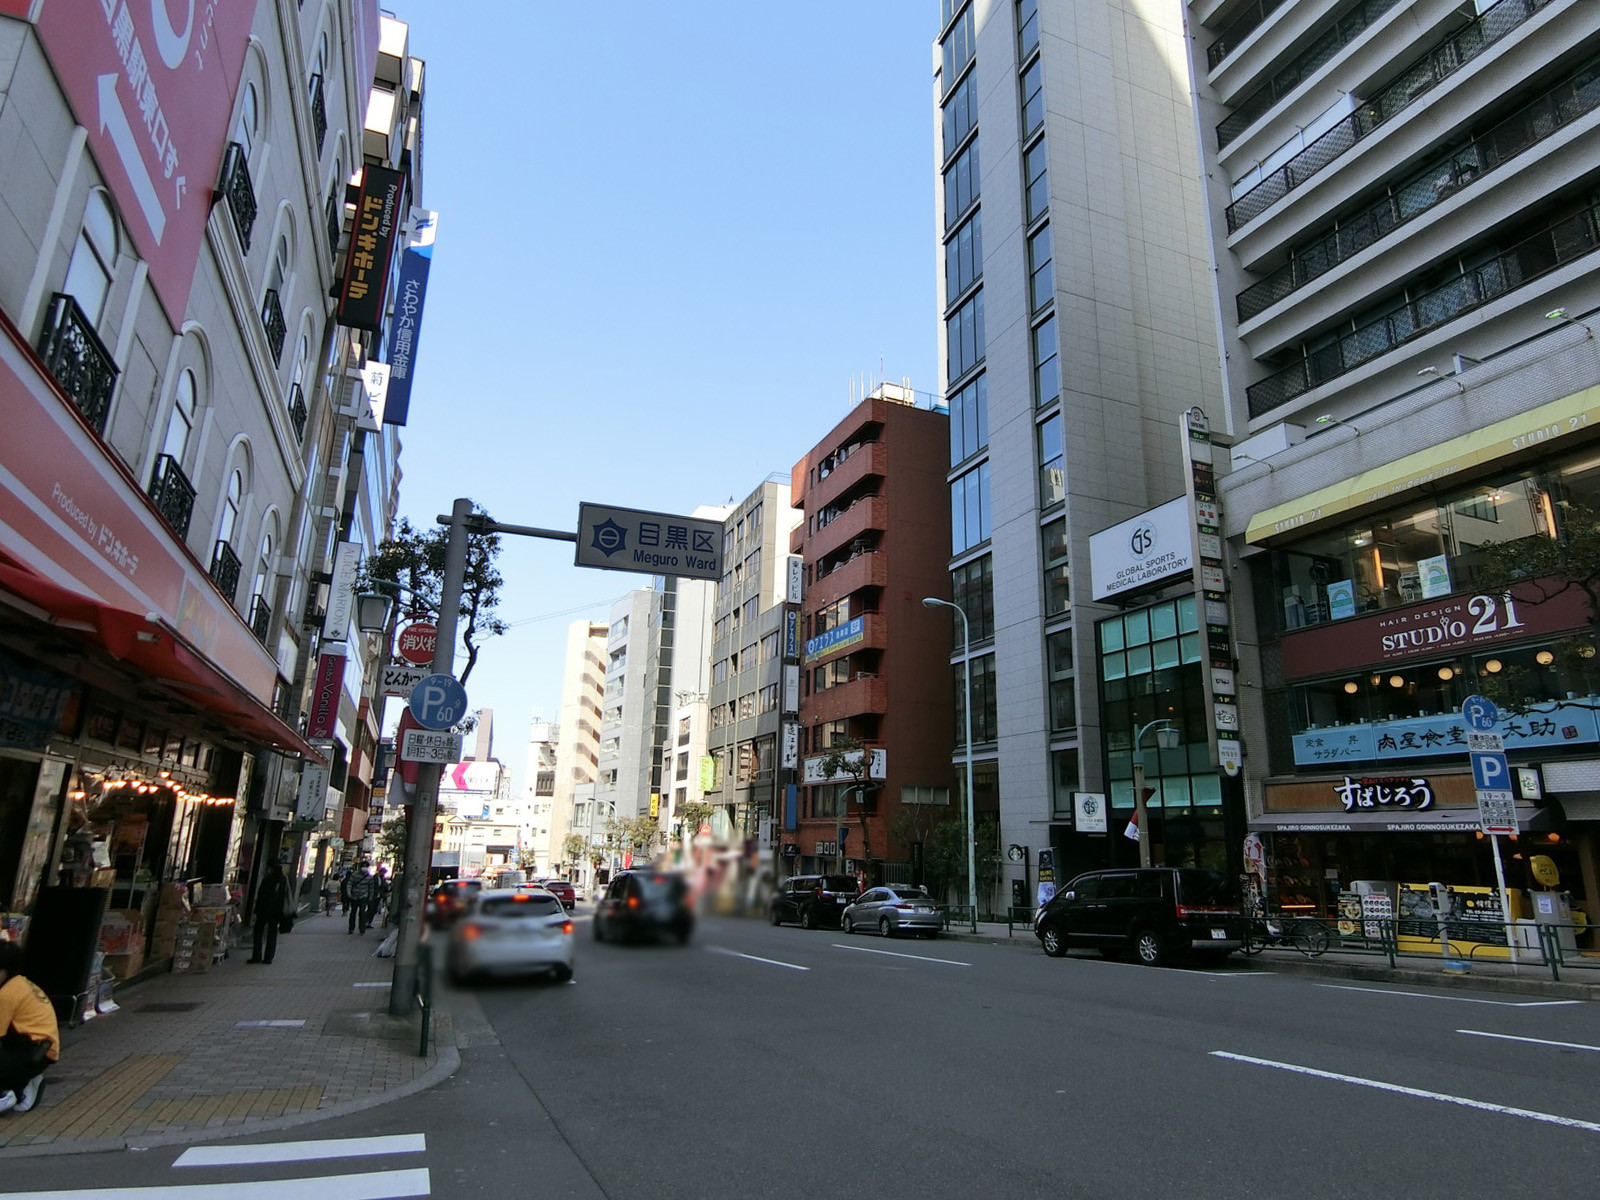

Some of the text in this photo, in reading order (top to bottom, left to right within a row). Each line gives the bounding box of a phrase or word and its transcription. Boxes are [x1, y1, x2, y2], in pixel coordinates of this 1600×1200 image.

[379, 184, 398, 238] Produced by
[391, 278, 420, 380] さわやか信用金庫
[52, 482, 89, 528] Produced
[86, 517, 98, 541] by
[639, 522, 714, 554] 目黒区
[633, 548, 717, 571] Meguro Ward
[1106, 576, 1136, 592] MEDICAL
[1137, 556, 1189, 581] LABORATORY
[1116, 551, 1175, 579] GLOBAL SPORTS
[332, 546, 355, 626] ALICE MARION
[1380, 604, 1462, 628] HAIR DESIGN
[1382, 589, 1525, 652] STUDIO 21
[420, 686, 446, 721] P
[437, 706, 454, 722] 60
[1377, 725, 1465, 752] 肉屋食堂
[1502, 718, 1557, 740] 太助
[1313, 747, 1362, 759] サラダバー
[1479, 756, 1502, 787] P
[1334, 776, 1432, 811] すぱじろう
[1277, 824, 1299, 832] SPAJIRO
[1386, 823, 1480, 831] SPAJIRO GONNOSUKEZAKA
